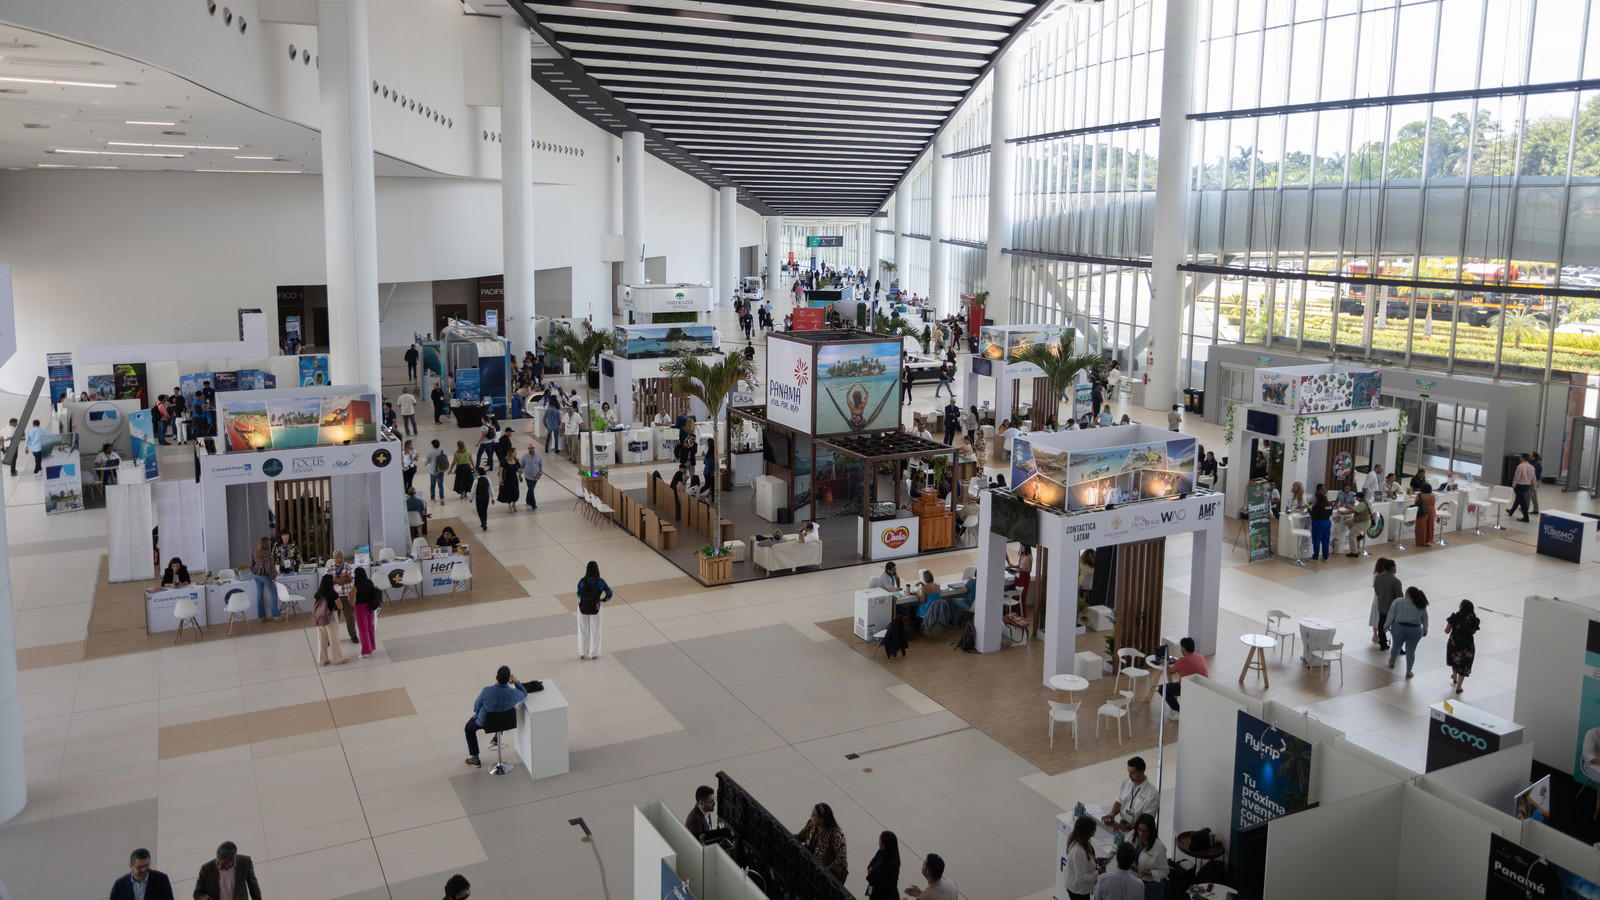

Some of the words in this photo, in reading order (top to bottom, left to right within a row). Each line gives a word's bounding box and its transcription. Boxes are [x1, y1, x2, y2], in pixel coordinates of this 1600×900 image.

[733, 394, 753, 403] CASA
[1066, 522, 1096, 535] CONTACTICA
[1073, 532, 1090, 543] LATAM
[1244, 731, 1281, 760] flytrip
[1242, 771, 1257, 788] Tu
[1241, 785, 1287, 815] próxima
[1493, 860, 1546, 895] Panamá
